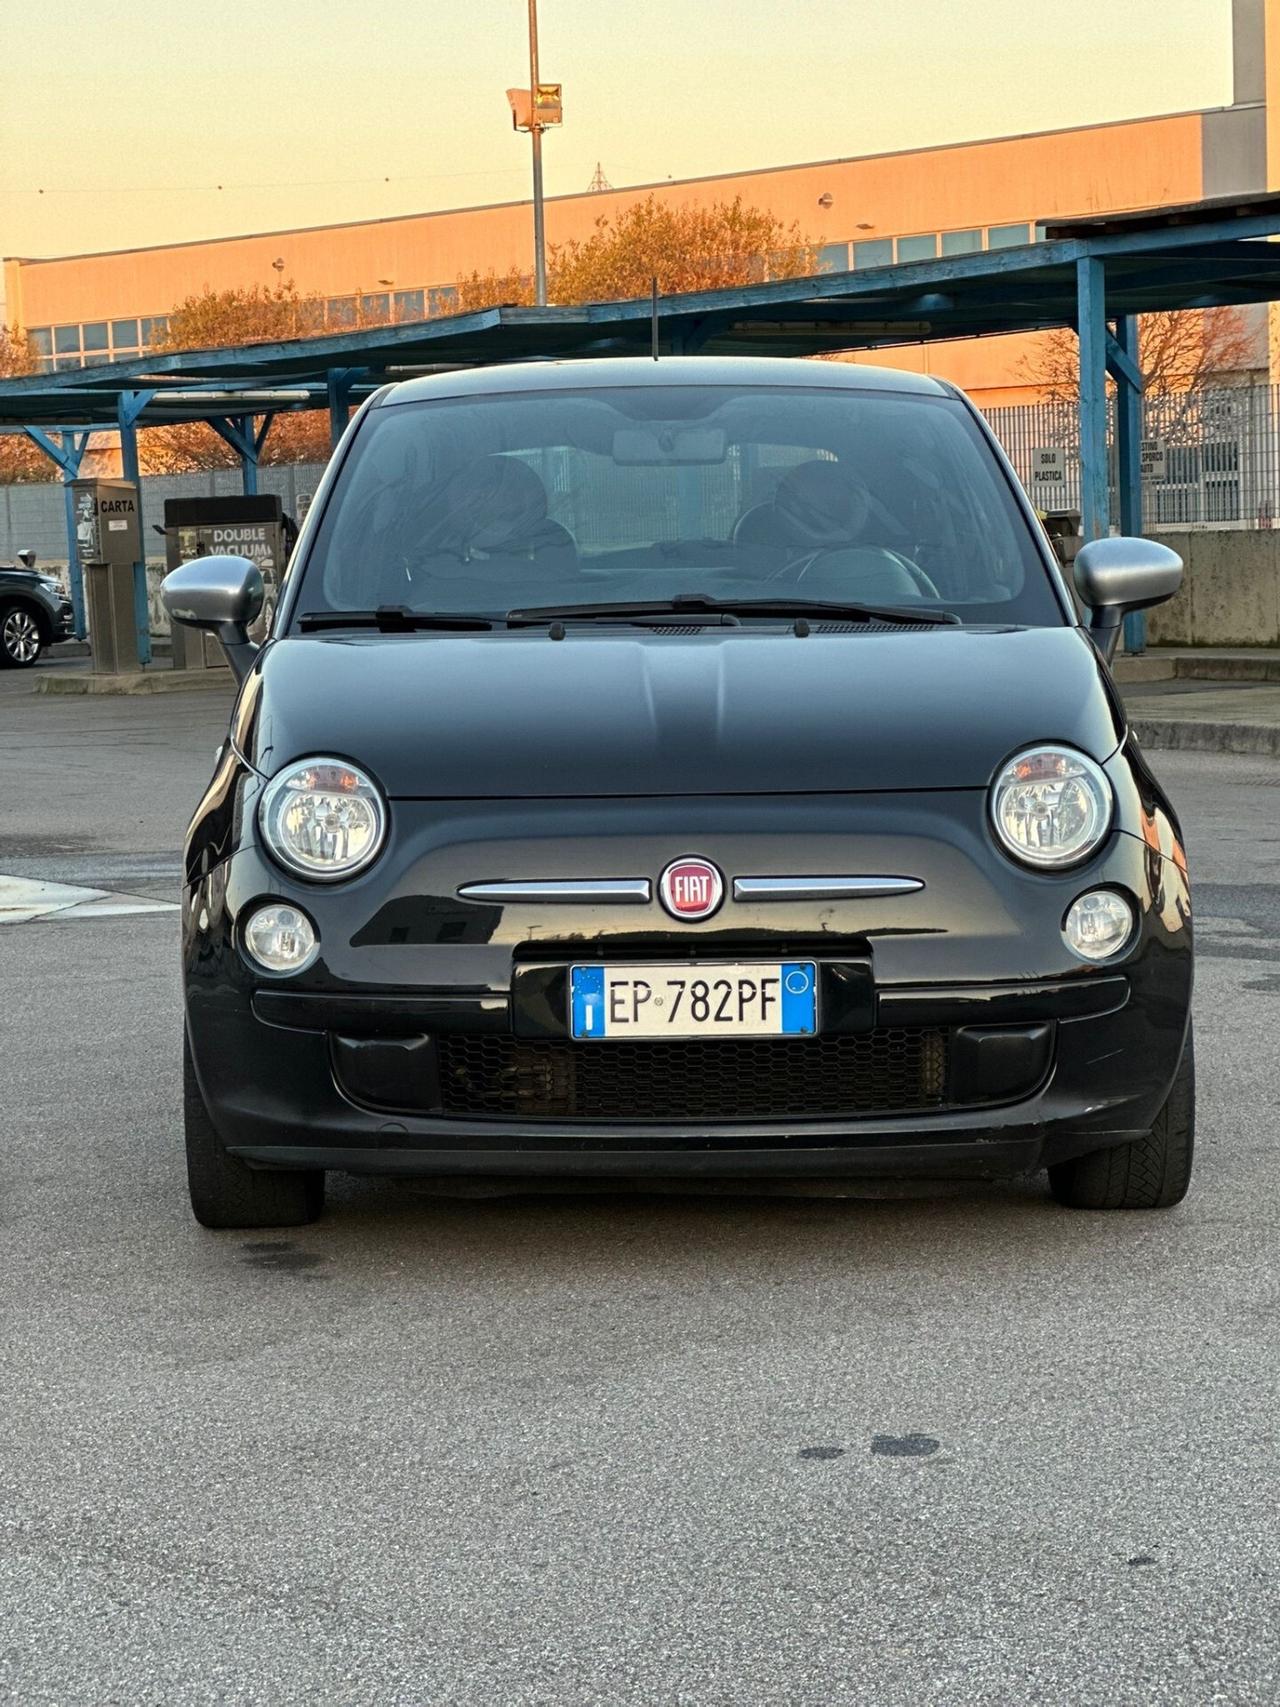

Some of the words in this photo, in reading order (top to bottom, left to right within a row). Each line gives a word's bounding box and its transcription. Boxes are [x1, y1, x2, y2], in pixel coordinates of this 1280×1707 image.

[1041, 453, 1056, 464] SOLO
[1035, 471, 1062, 481] PLASTICA
[101, 500, 135, 513] CARTA
[213, 528, 266, 543] DOUBLE
[674, 875, 709, 902] FIAT
[609, 981, 652, 1023] EP
[666, 978, 780, 1023] 782PF
